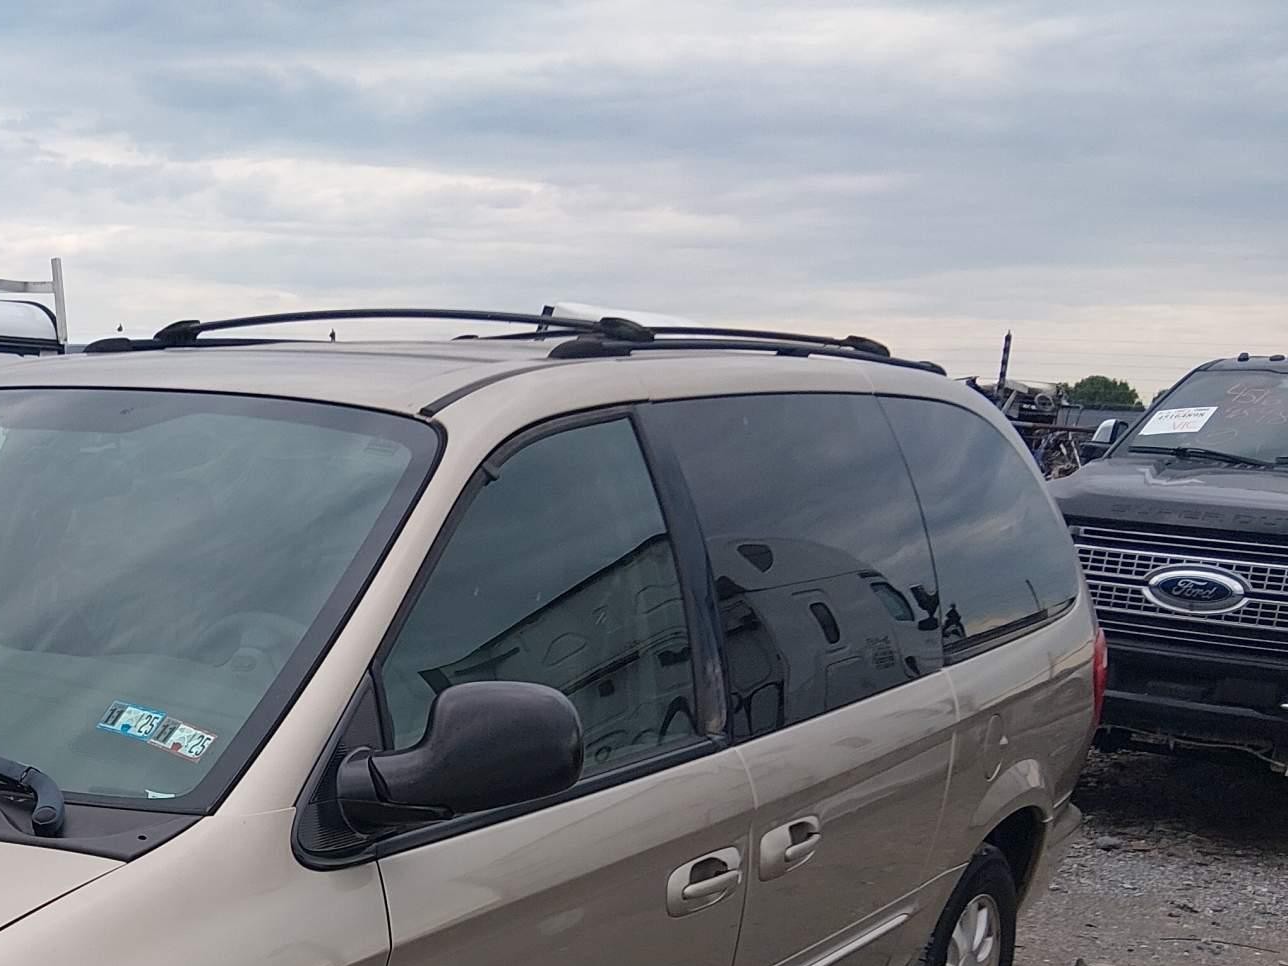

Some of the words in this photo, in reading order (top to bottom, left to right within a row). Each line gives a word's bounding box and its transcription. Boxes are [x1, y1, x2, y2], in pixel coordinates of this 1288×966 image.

[1171, 578, 1219, 600] Ford
[137, 714, 160, 736] 25
[188, 734, 212, 757] 25
